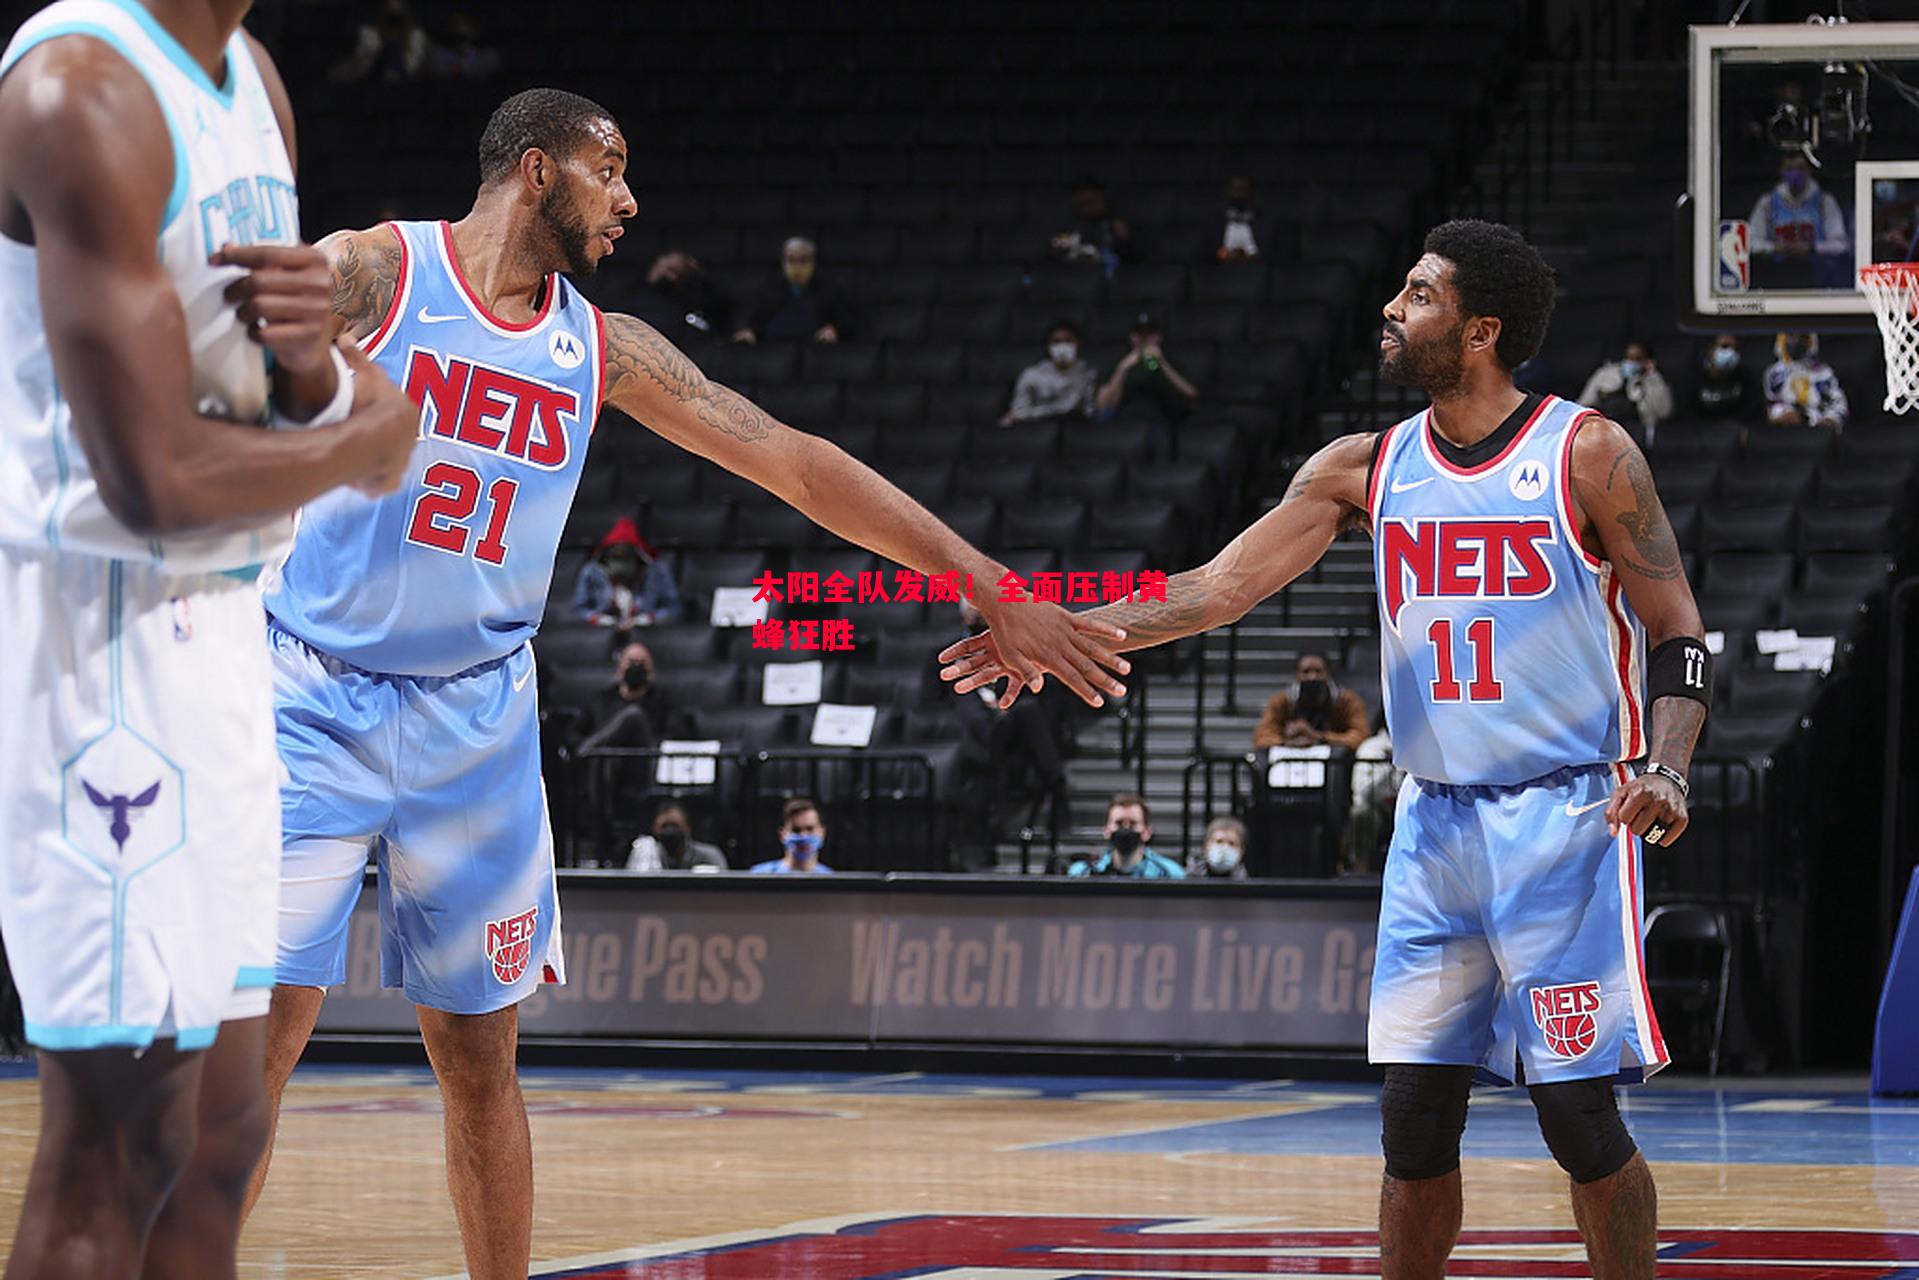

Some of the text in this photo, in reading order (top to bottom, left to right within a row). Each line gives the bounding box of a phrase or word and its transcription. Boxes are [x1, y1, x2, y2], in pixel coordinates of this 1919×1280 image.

[402, 344, 581, 471] NETS
[405, 459, 520, 568] 21
[1378, 515, 1558, 638] NETS
[1426, 617, 1504, 703] 11
[1684, 646, 1704, 663] KAI
[1685, 659, 1704, 688] 11
[485, 905, 539, 961] NETS
[629, 915, 768, 1006] Pass
[850, 919, 1022, 1010] Watch
[1037, 923, 1177, 1012] More
[1194, 926, 1304, 1014] Live
[1530, 981, 1601, 1030] NETS
